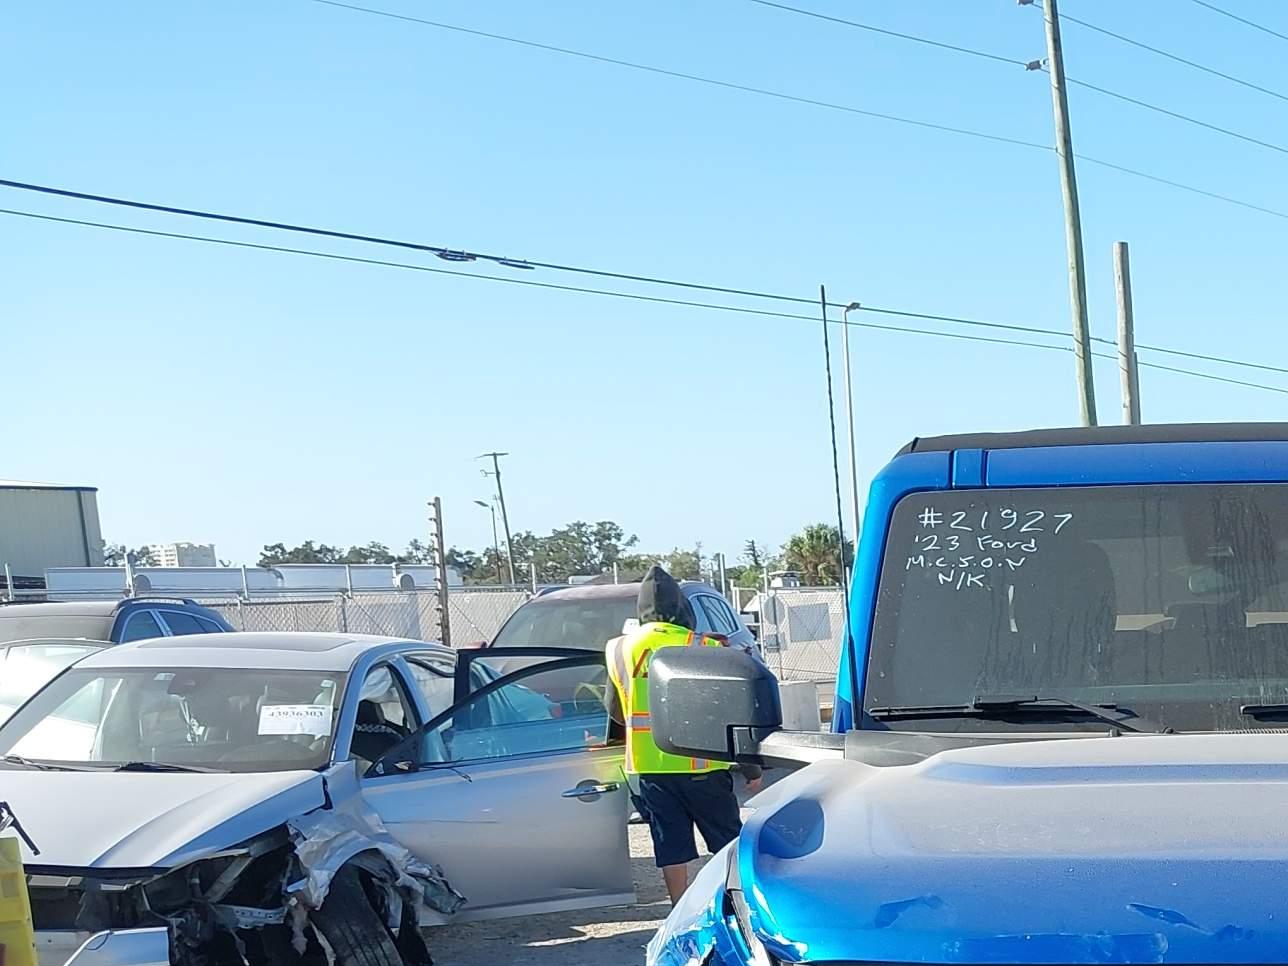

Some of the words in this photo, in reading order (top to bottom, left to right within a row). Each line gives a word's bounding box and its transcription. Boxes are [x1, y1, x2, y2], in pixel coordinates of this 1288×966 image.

[918, 507, 1073, 534] #21927
[914, 534, 960, 552] '23
[976, 534, 1038, 552] Ford
[937, 570, 985, 590] N/K
